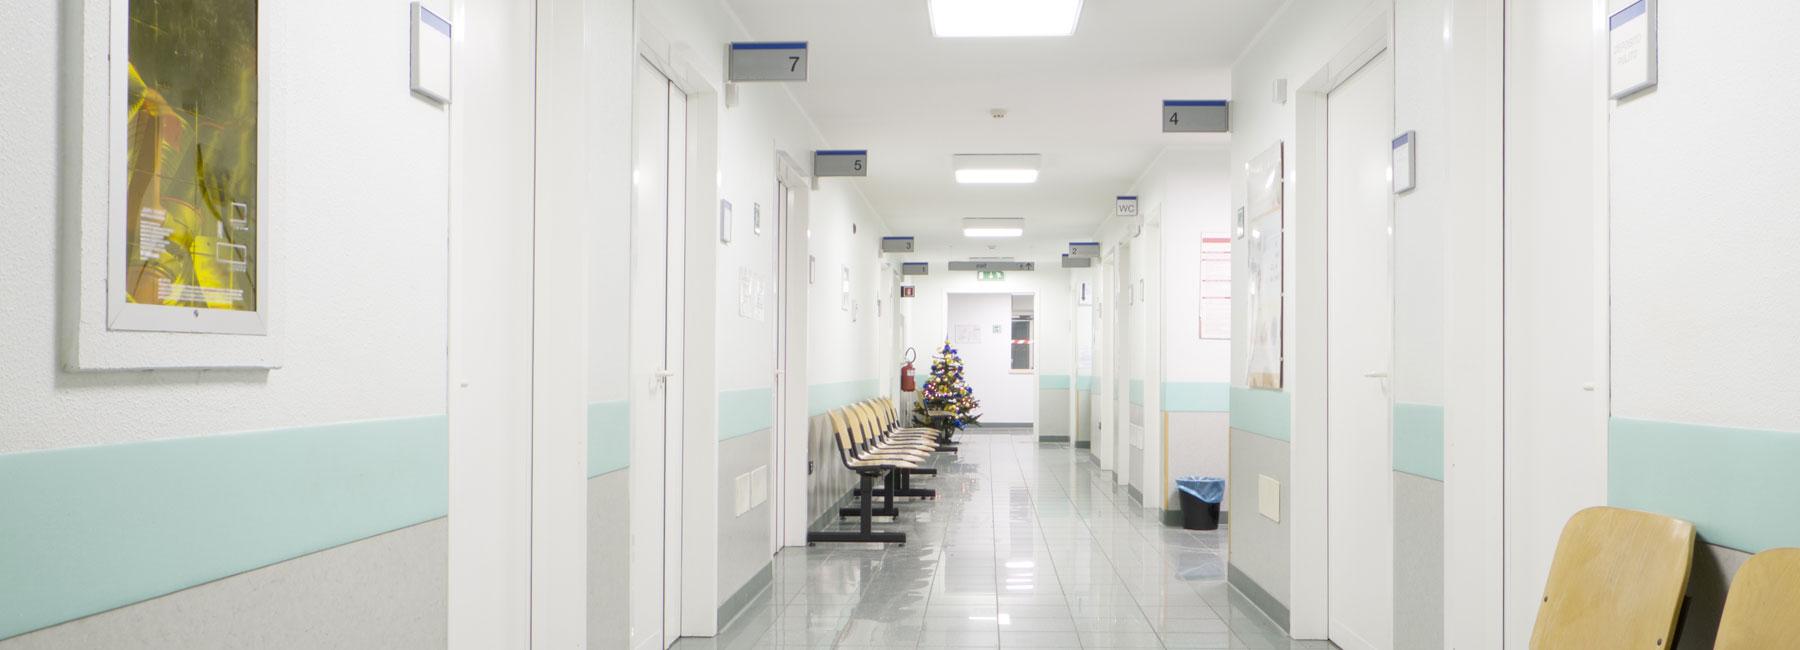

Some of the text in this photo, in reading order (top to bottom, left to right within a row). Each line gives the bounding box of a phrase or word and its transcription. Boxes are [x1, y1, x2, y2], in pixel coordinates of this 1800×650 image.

[789, 56, 800, 72] 7
[1169, 112, 1179, 126] 4
[854, 159, 862, 171] 5
[1119, 204, 1135, 213] WC
[906, 242, 912, 250] 3
